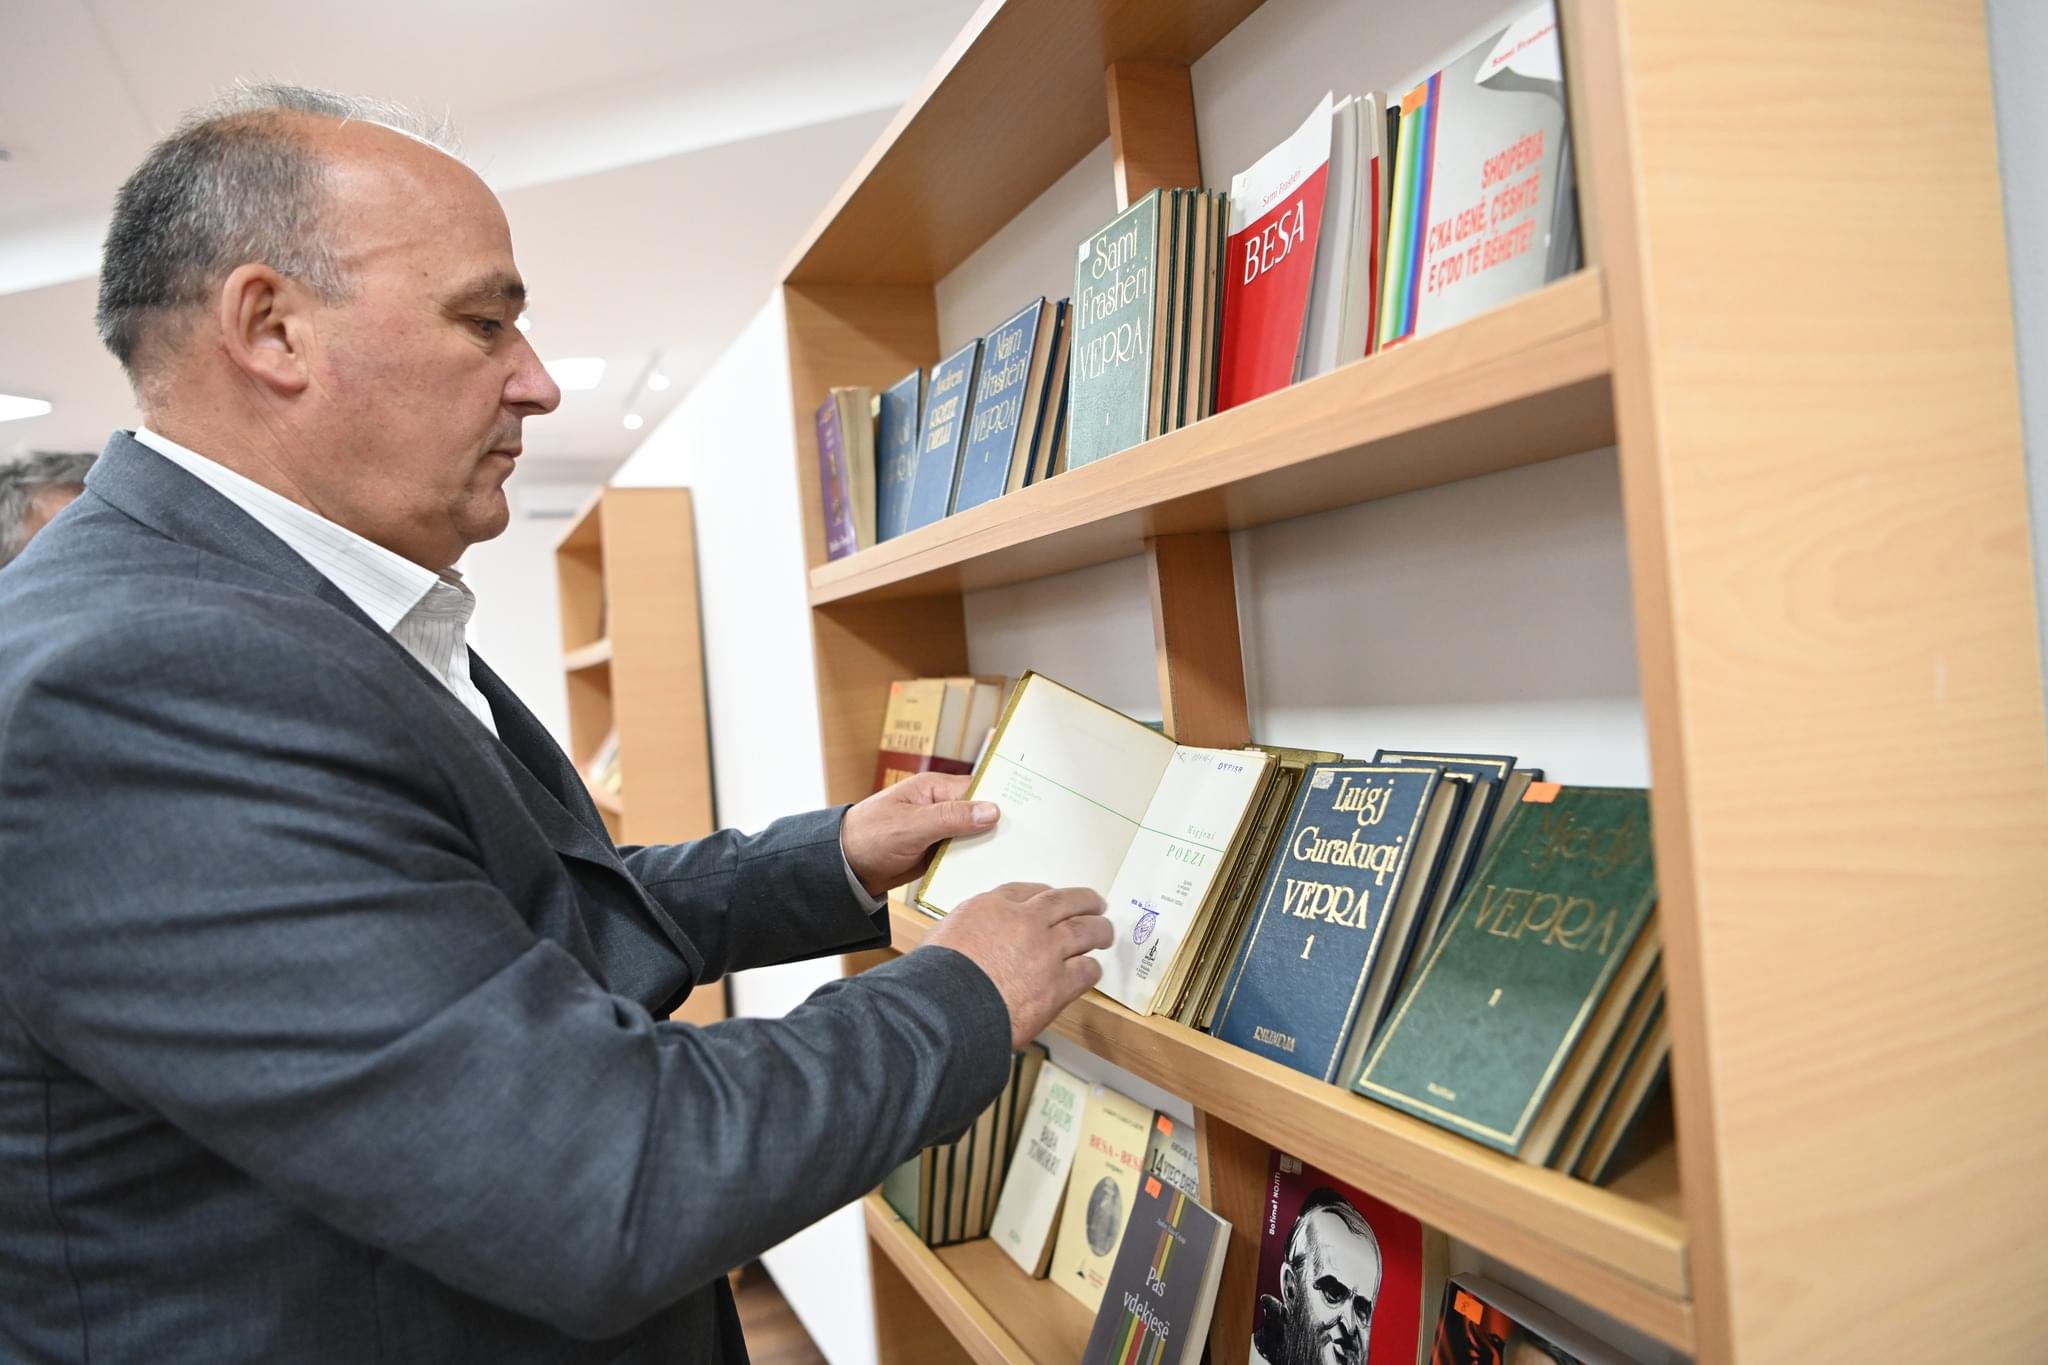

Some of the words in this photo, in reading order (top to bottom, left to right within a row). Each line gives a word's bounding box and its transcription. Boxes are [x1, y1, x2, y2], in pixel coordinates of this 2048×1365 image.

[1481, 127, 1544, 189] SHQIPËRIA
[1092, 219, 1138, 280] Sami
[1244, 200, 1304, 286] BESA
[1081, 255, 1149, 330] Frashëri
[1427, 263, 1437, 293] E
[991, 327, 1023, 366] Naim
[1080, 316, 1143, 383] VEPRA
[978, 349, 1029, 404] Frashëri
[973, 395, 1018, 445] VEPRA
[1332, 775, 1395, 825] Luigj
[1165, 844, 1206, 867] POEZI
[1293, 826, 1403, 886] Gurakuqi
[1282, 878, 1371, 930] VEPRA
[1474, 884, 1619, 956] VEPRA
[1299, 933, 1315, 960] 1
[1149, 1147, 1165, 1173] 14
[1268, 1199, 1279, 1236] Botimet
[1145, 1265, 1166, 1297] Pas
[1123, 1290, 1171, 1342] vdekjesë
